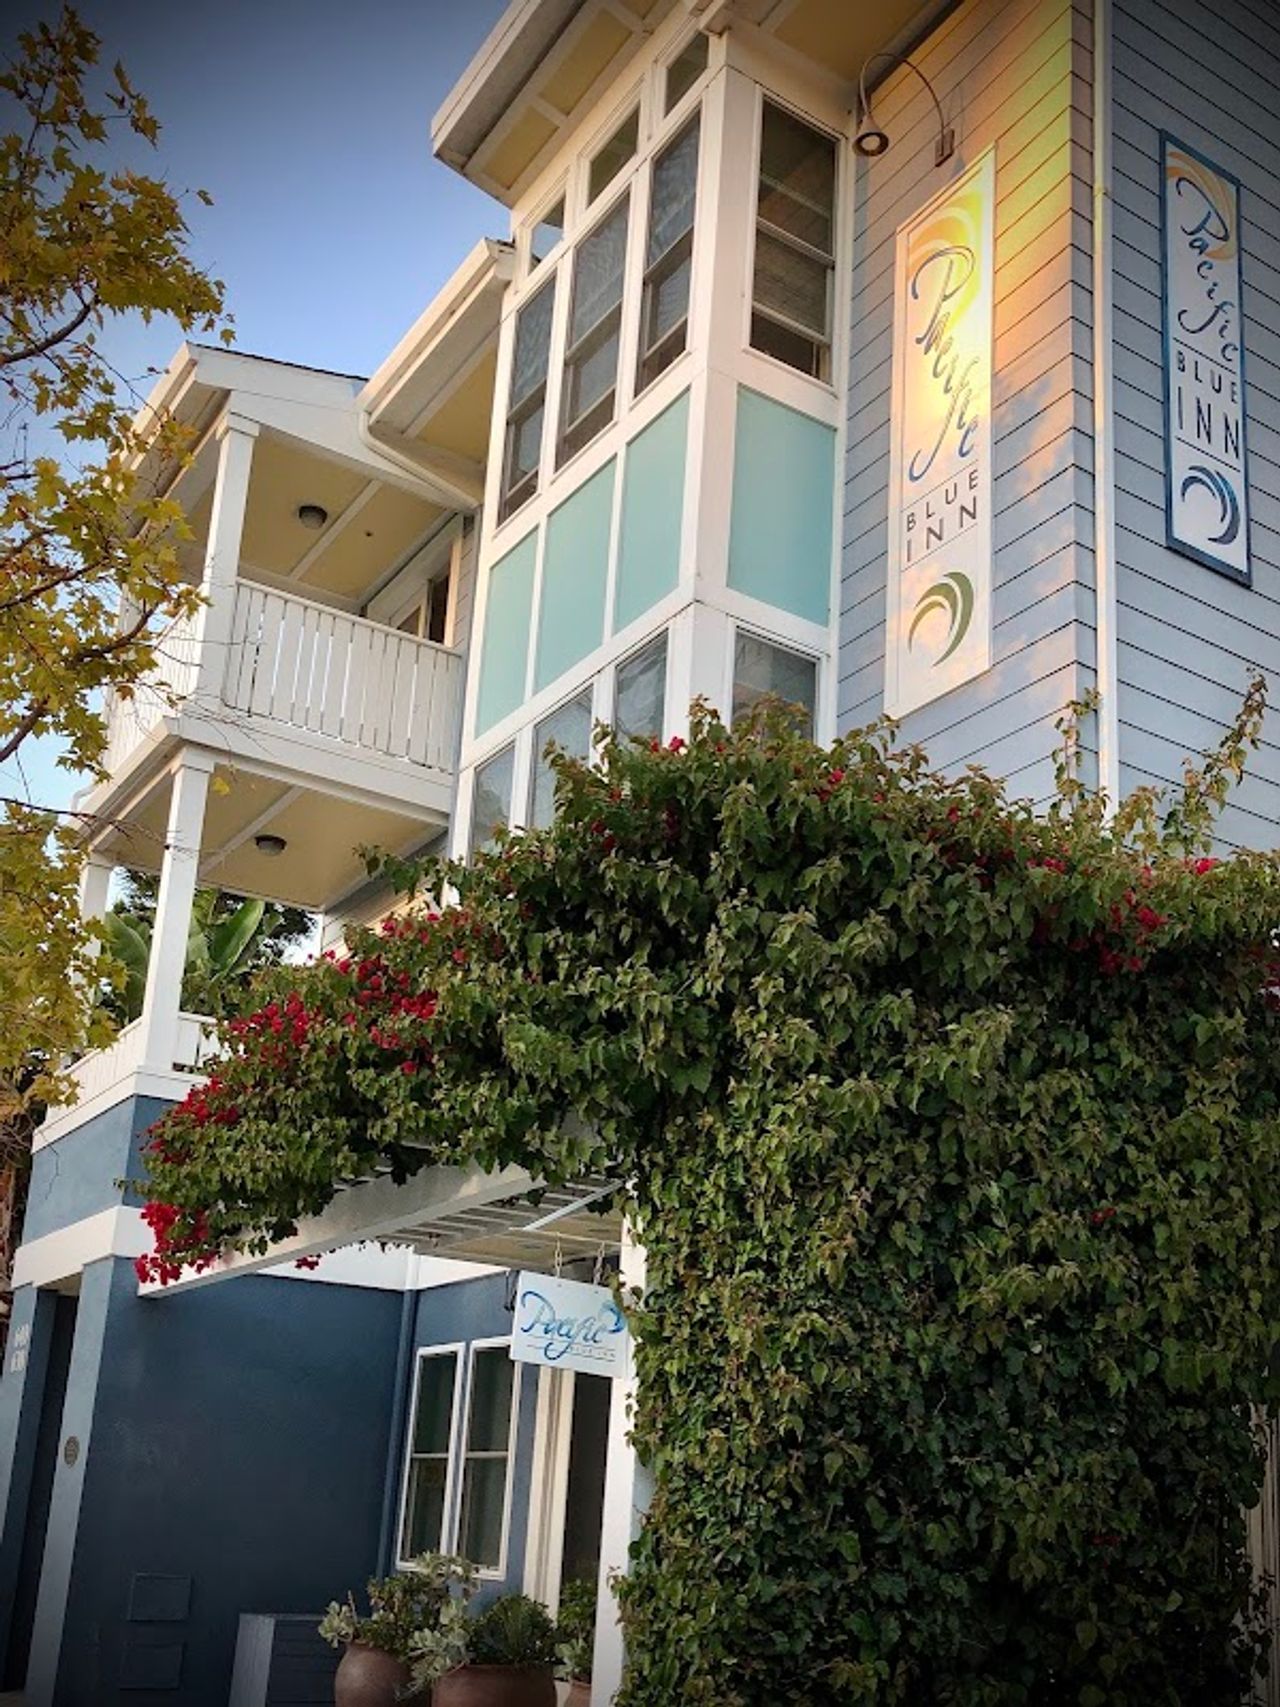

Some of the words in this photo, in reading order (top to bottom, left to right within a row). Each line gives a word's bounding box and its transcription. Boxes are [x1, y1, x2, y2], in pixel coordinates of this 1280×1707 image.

[1176, 178, 1239, 361] Pacific
[909, 246, 979, 481] Pacific
[1177, 350, 1238, 404] BLUE
[1178, 387, 1239, 459] INN
[906, 497, 977, 562] INN
[907, 470, 979, 531] BLUE
